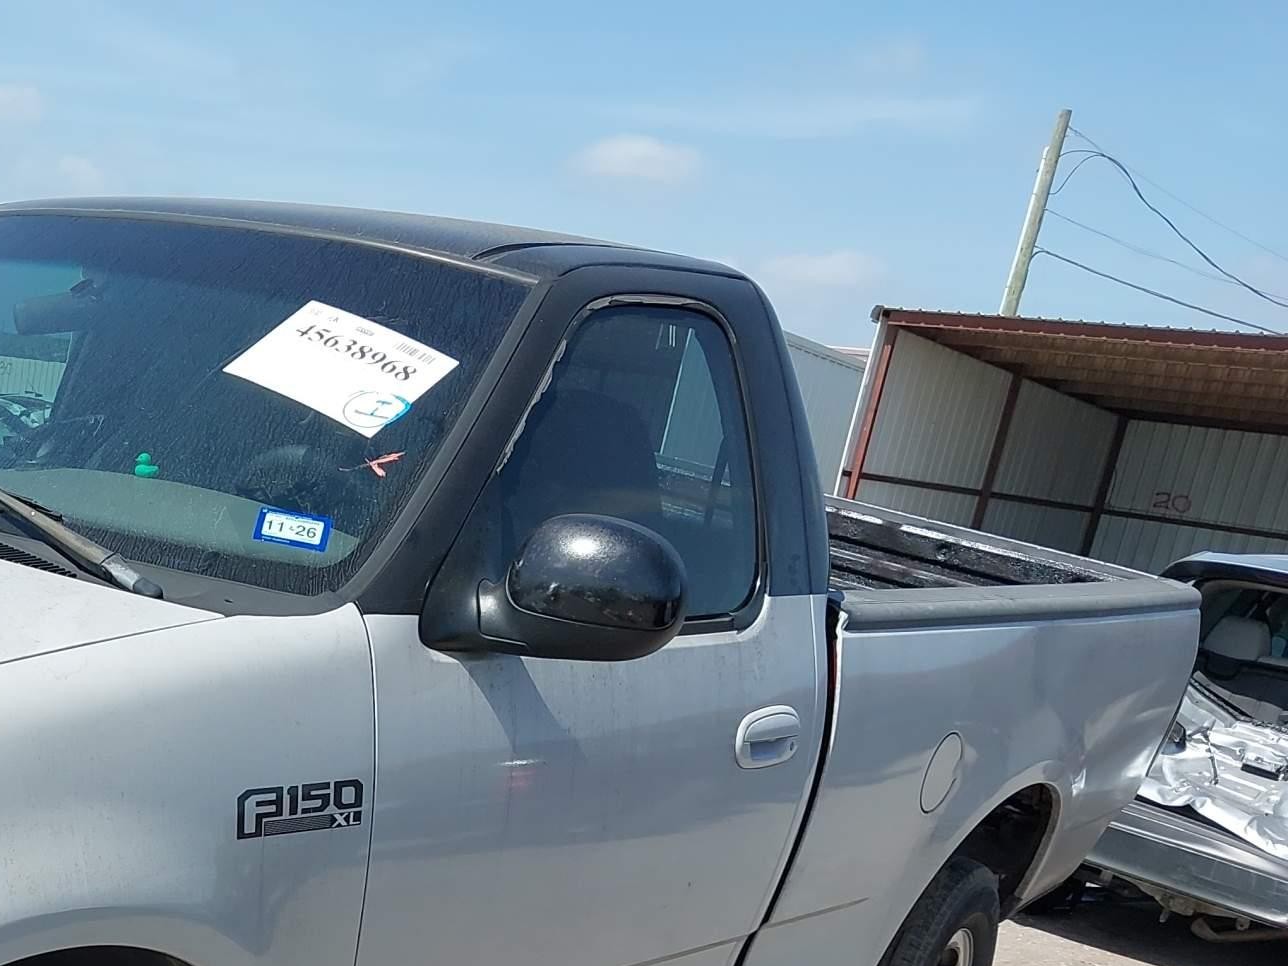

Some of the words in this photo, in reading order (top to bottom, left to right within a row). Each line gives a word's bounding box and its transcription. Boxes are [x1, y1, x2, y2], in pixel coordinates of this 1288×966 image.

[296, 324, 417, 381] 45638968
[1153, 492, 1192, 513] 20
[266, 519, 284, 532] 11
[295, 524, 317, 538] 26
[332, 812, 361, 828] XL
